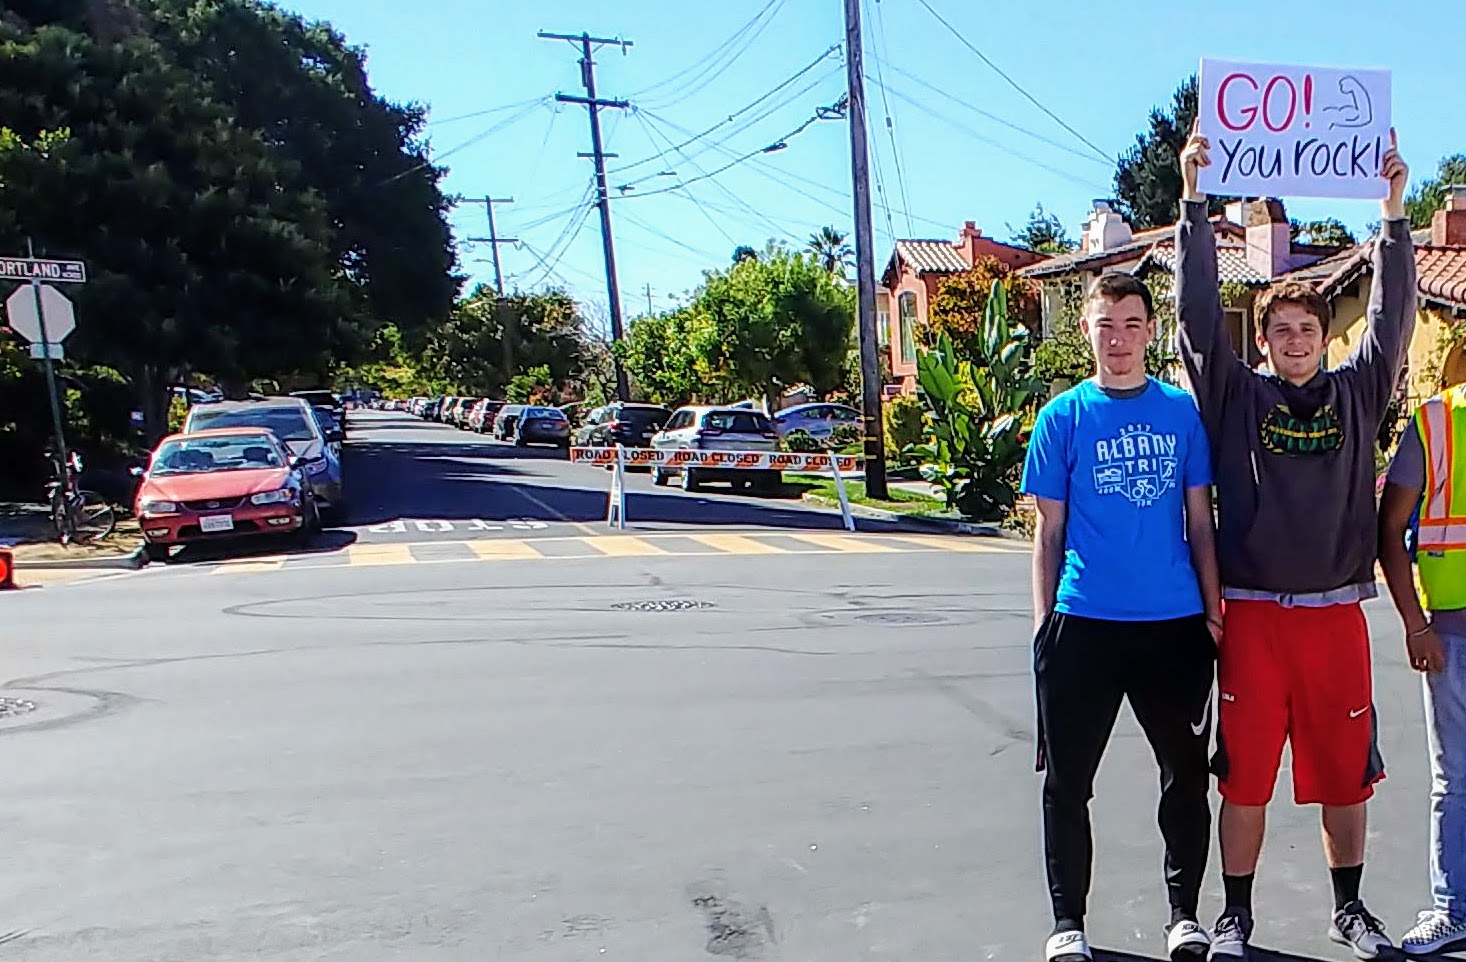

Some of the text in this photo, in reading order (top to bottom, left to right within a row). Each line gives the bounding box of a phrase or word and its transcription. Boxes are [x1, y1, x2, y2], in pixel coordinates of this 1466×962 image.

[1216, 72, 1313, 132] GO!
[0, 260, 61, 278] ORTLAND
[1096, 434, 1176, 462] ALBANY
[576, 449, 611, 461] ROAD
[674, 451, 708, 463] ROAD
[711, 452, 760, 465] CLOSED
[769, 454, 802, 466] ROAD
[1124, 458, 1157, 474] TRI
